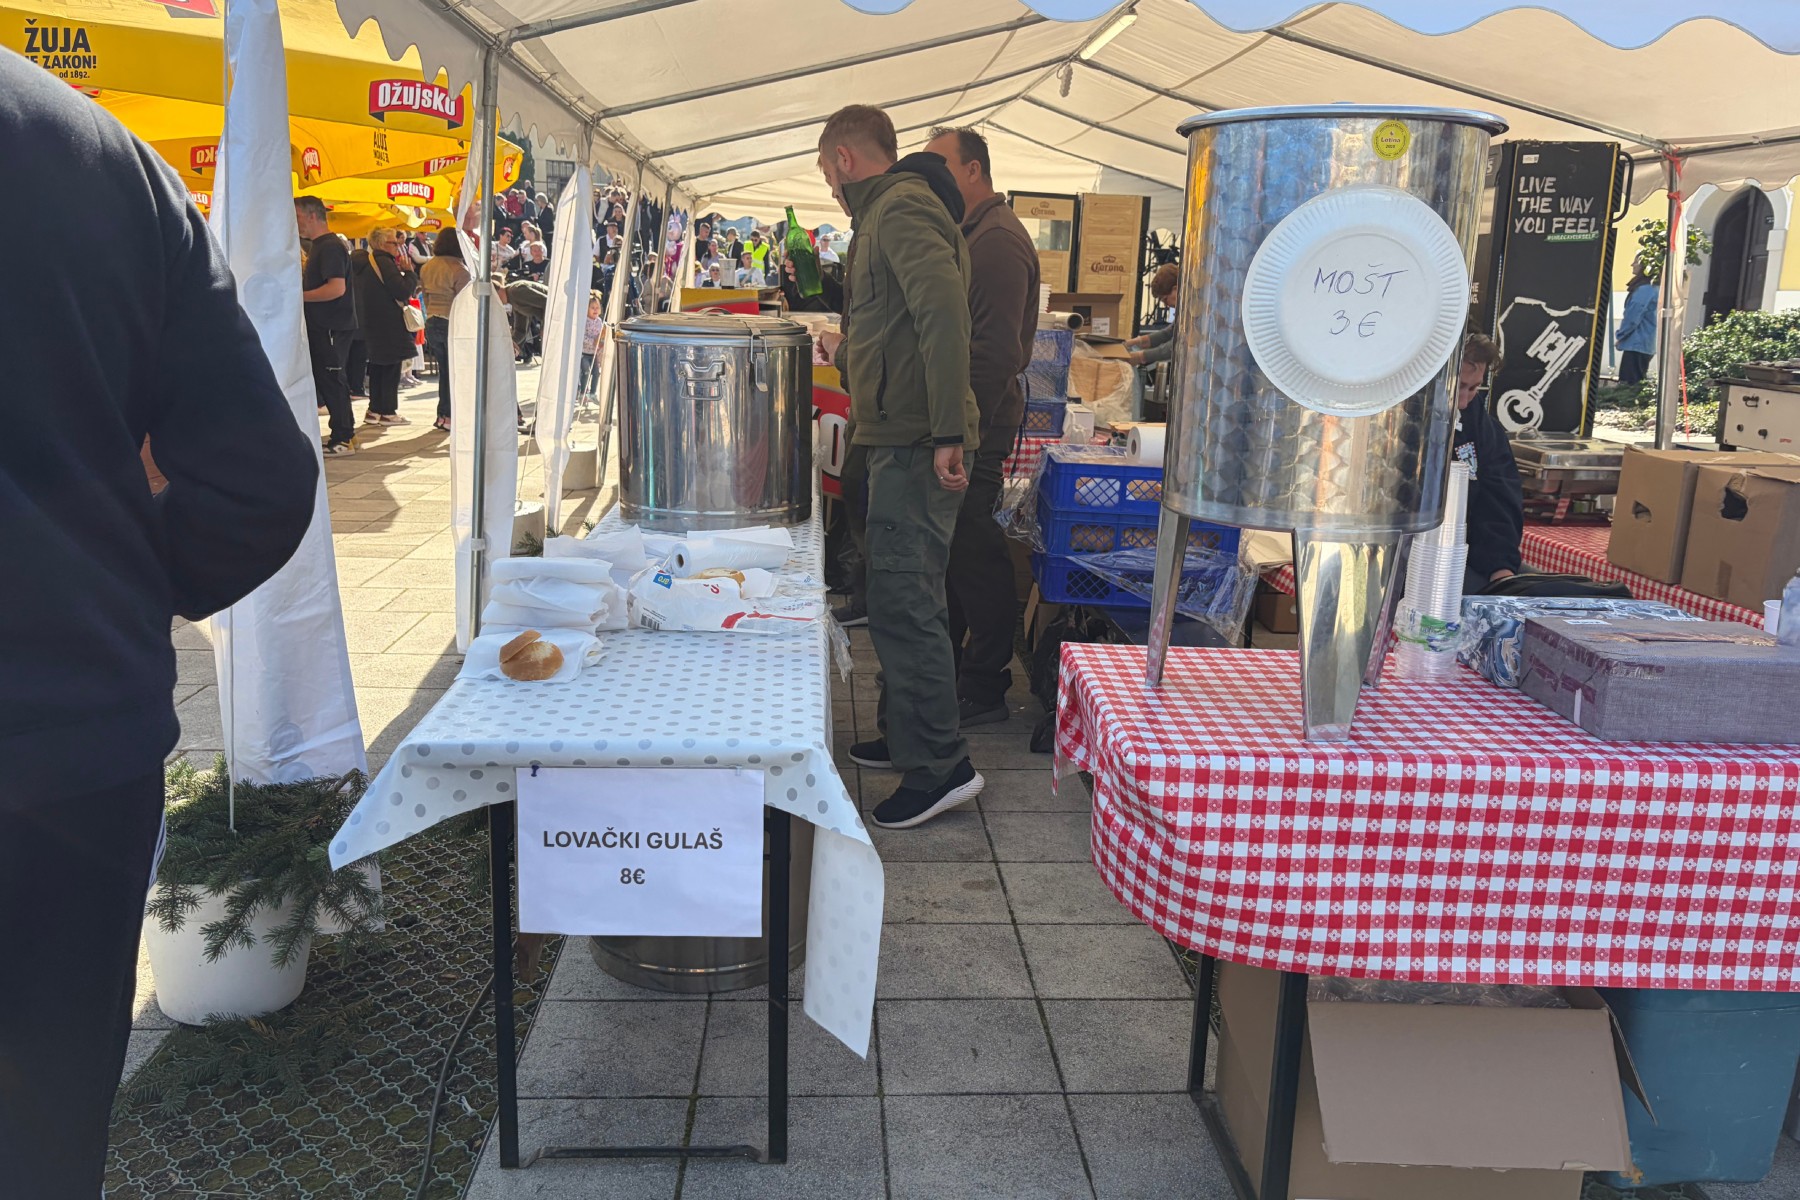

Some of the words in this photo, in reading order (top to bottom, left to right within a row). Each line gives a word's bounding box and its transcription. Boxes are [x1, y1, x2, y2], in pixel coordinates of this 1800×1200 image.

[24, 18, 92, 53] ŽUJA
[42, 55, 97, 69] ZAKON!
[59, 70, 69, 79] od
[70, 71, 91, 79] 1892.
[378, 82, 456, 116] Ožujsko
[1519, 176, 1557, 193] LIVE
[1030, 207, 1056, 217] Corona
[1517, 196, 1553, 214] THE
[1559, 196, 1595, 214] WAY
[1514, 217, 1546, 234] YOU
[1551, 217, 1600, 234] FEEL
[1090, 261, 1126, 274] Corona
[1313, 263, 1409, 299] MOŠT
[543, 826, 640, 849] LOVAČKI
[646, 827, 724, 850] GULAŠ
[619, 868, 646, 885] 8€
